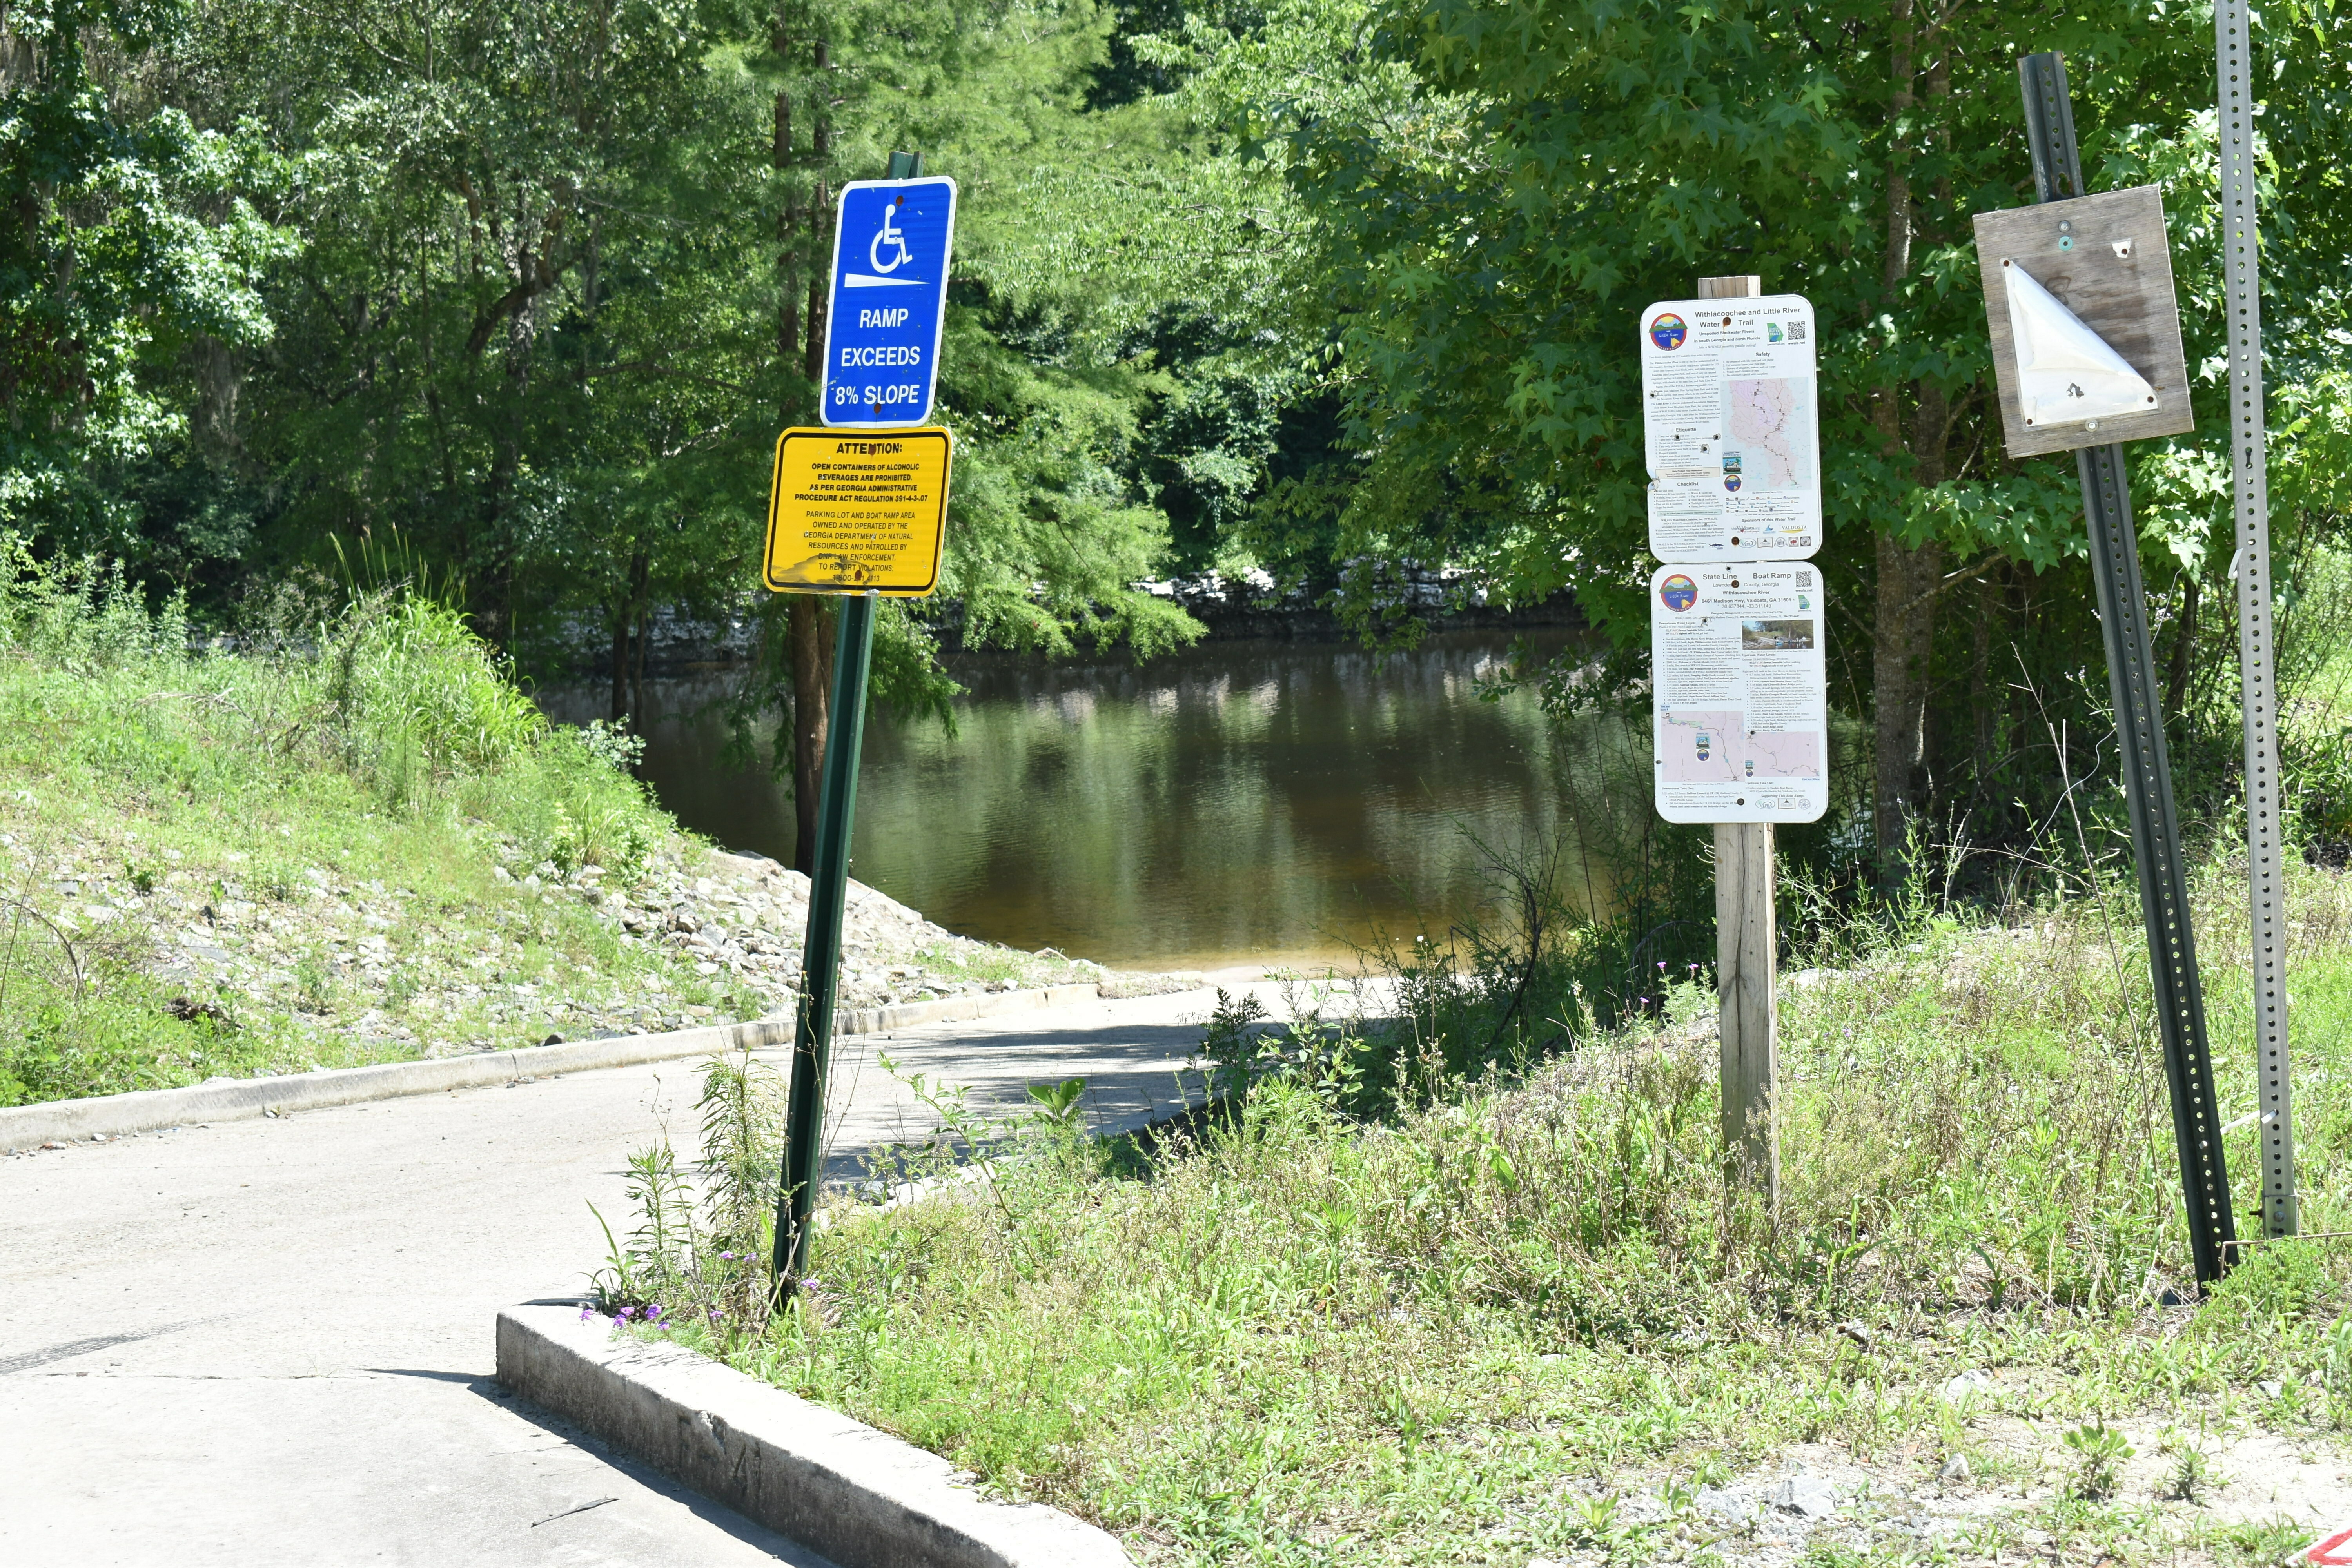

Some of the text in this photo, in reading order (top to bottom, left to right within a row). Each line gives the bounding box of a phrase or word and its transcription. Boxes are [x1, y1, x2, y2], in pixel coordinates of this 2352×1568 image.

[860, 309, 908, 328] RAMP
[841, 347, 920, 366] EXCEEDS
[835, 385, 920, 405] 8% SLOPE
